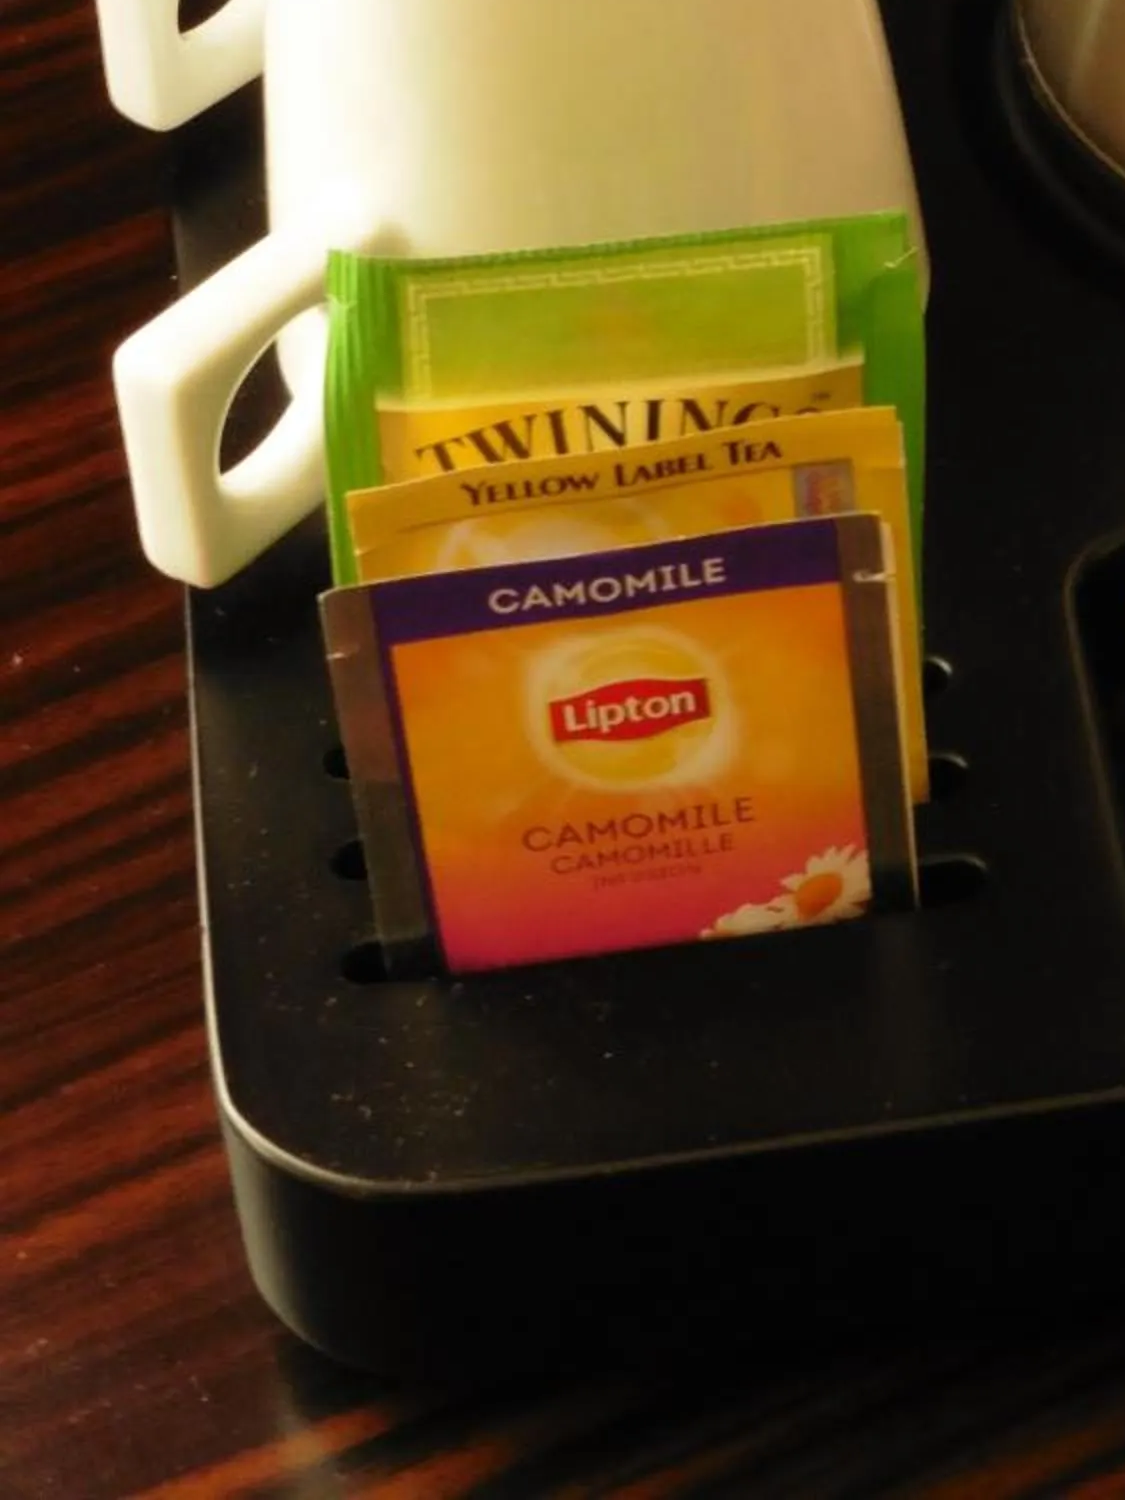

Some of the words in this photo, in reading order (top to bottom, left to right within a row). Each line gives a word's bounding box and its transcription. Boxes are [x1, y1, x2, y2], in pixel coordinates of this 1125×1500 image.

[461, 466, 597, 507] YELLOW
[614, 454, 713, 488] LABEL
[728, 438, 783, 466] TEA
[488, 557, 728, 615] CAMOMILE
[563, 689, 697, 734] Lipton
[521, 796, 758, 853] CAMOMILE
[549, 832, 736, 876] CAMOMILLE
